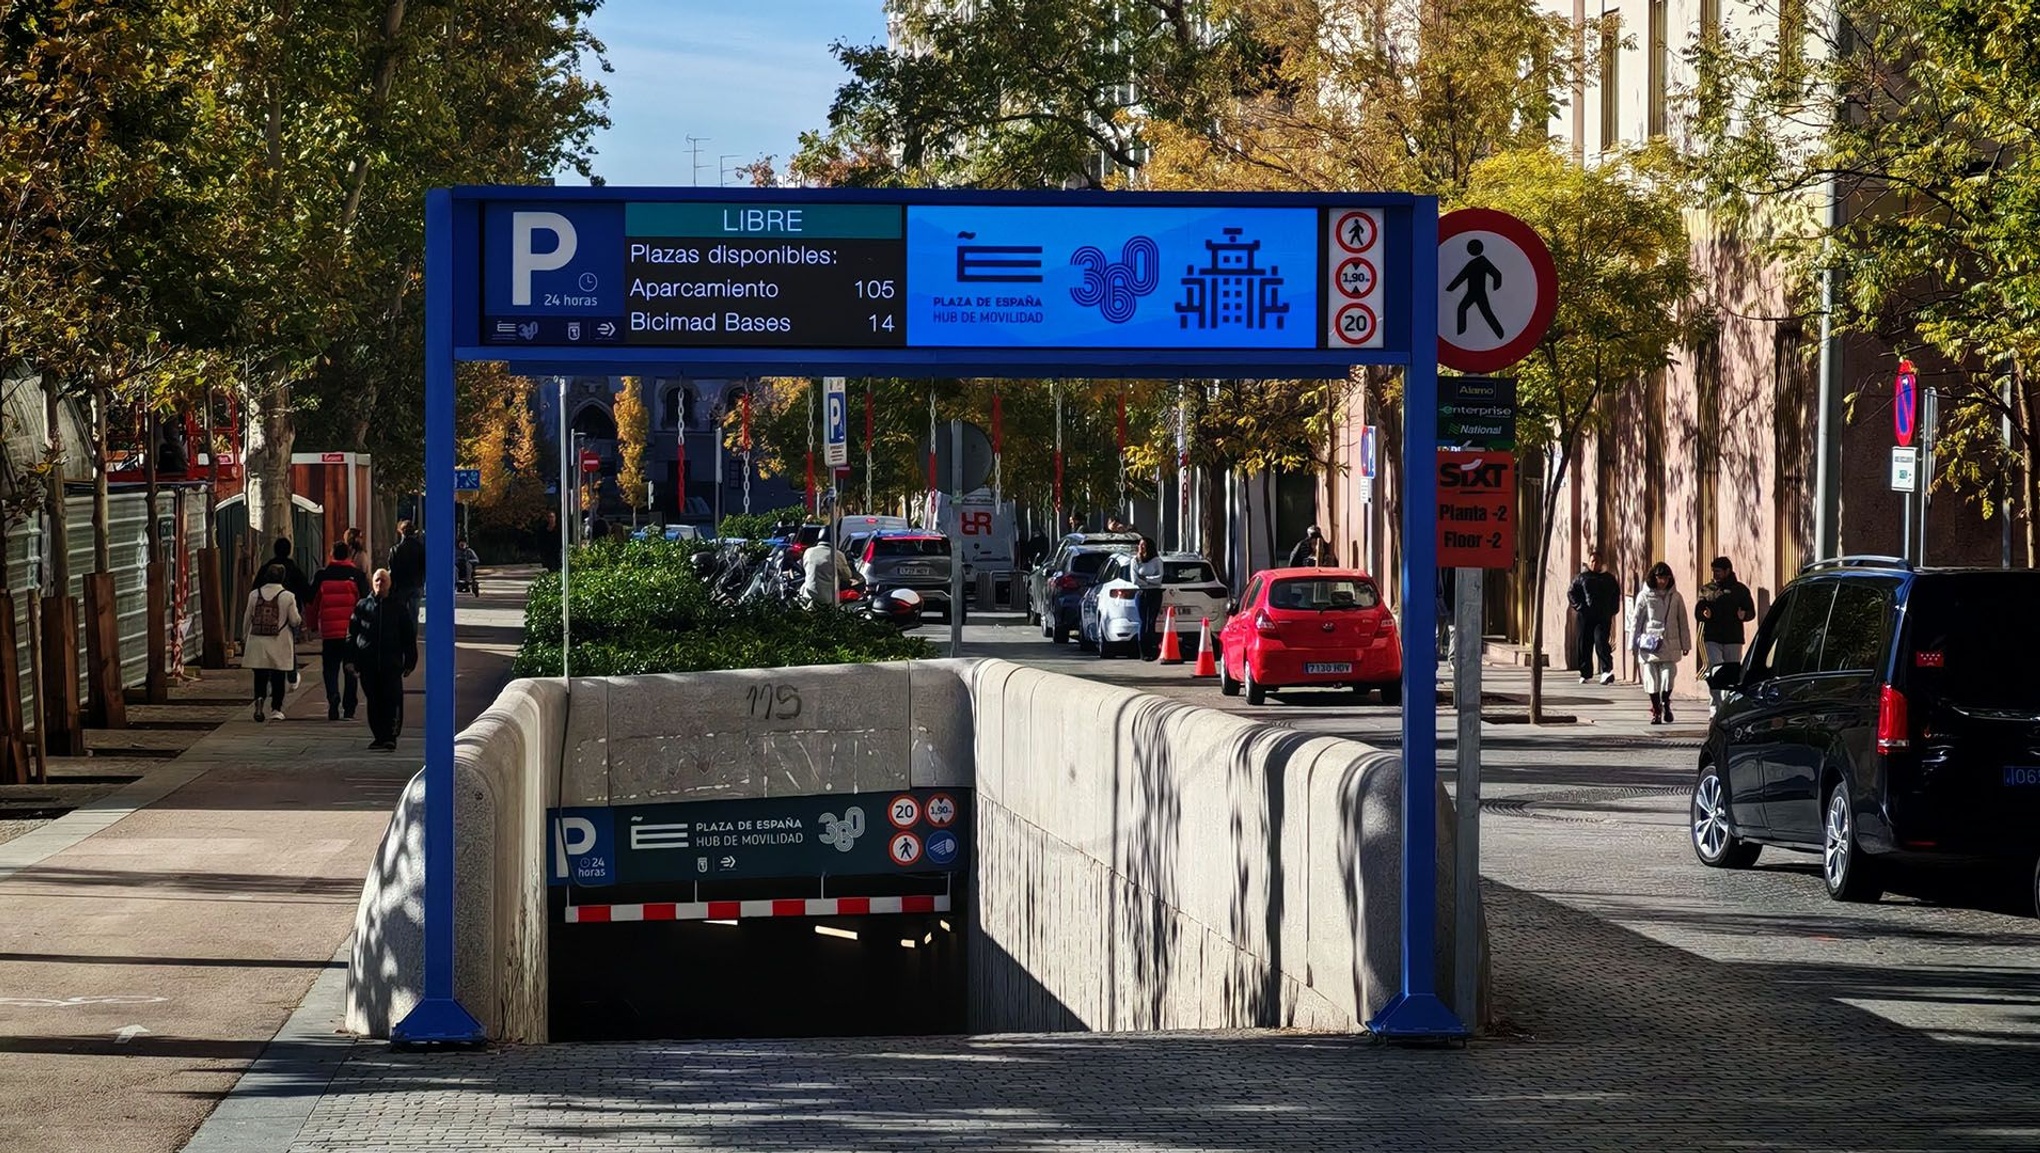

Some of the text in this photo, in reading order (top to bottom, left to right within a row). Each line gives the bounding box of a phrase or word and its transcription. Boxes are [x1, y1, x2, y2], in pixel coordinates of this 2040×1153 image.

[723, 209, 803, 232] LIBRE
[512, 211, 578, 306] P
[630, 244, 838, 270] Plazas disponibles:
[1069, 235, 1160, 324] 360
[629, 278, 895, 301] Aparcamiento 105
[543, 293, 598, 306] 24 horas
[932, 294, 1043, 307] PLAZA DE ESPAÑA
[630, 312, 895, 333] Bicimad Bases 14
[932, 311, 1044, 323] HUB DE MOVILIDAD
[1343, 314, 1368, 332] 20
[1458, 385, 1495, 395] Alamo
[829, 398, 841, 439] P
[1440, 405, 1512, 417] enterprise
[1460, 424, 1502, 435] National
[1439, 503, 1508, 522] Planta -2
[1443, 530, 1502, 549] Floor -2
[895, 804, 914, 819] 20
[695, 816, 803, 832] PLAZA DE ESPAÑA
[818, 806, 866, 852] 360
[554, 816, 597, 878] P
[695, 832, 804, 847] HUB DE MOVILIDAD
[591, 857, 605, 868] 24
[577, 866, 606, 878] horas
